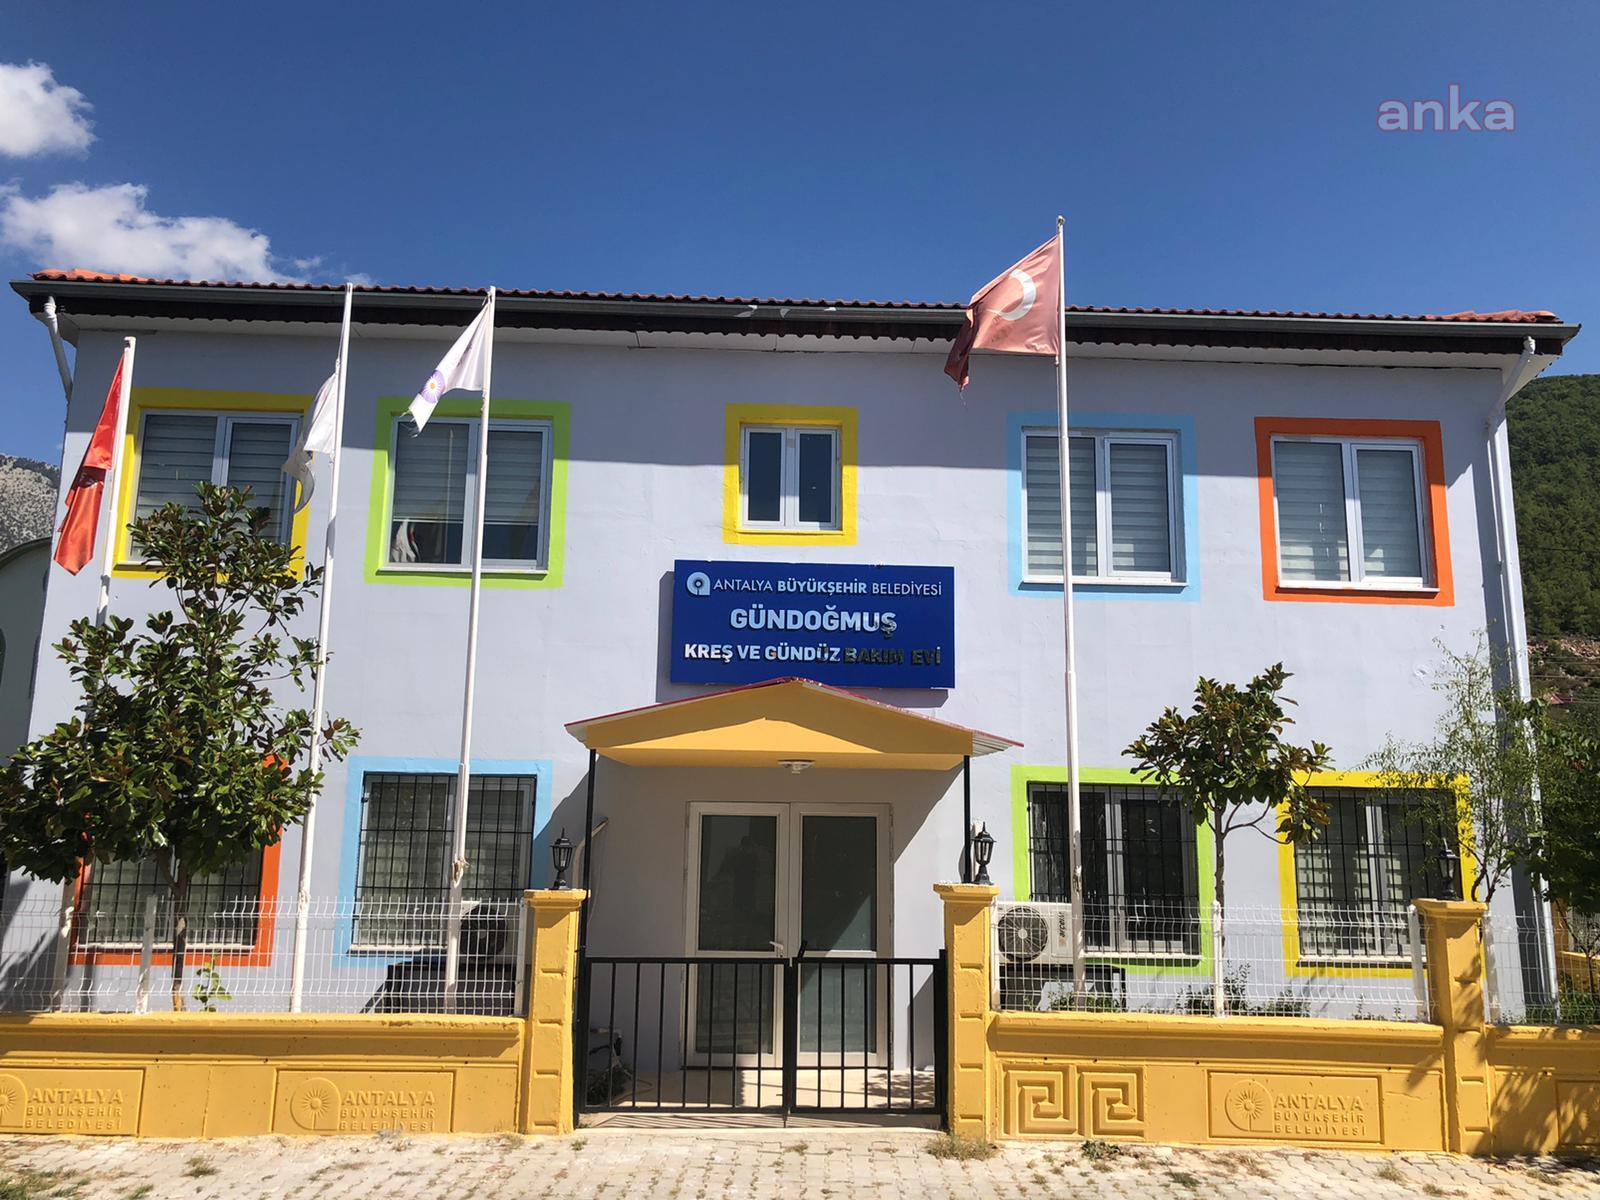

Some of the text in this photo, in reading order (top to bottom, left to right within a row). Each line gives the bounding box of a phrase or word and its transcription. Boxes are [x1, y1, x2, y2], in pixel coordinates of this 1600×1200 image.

[713, 578, 943, 596] ANTALYA BÜYÜKŞEHİR BELEDİYESİ
[730, 603, 898, 639] GÜNDOĞMUŞ
[684, 642, 942, 665] KREŞ VE GÜNDÜZ BAKIM EVİ
[28, 1088, 123, 1104] ANTALYA
[341, 1090, 436, 1106] ANTALYA
[1273, 1094, 1364, 1111] ANTALYA
